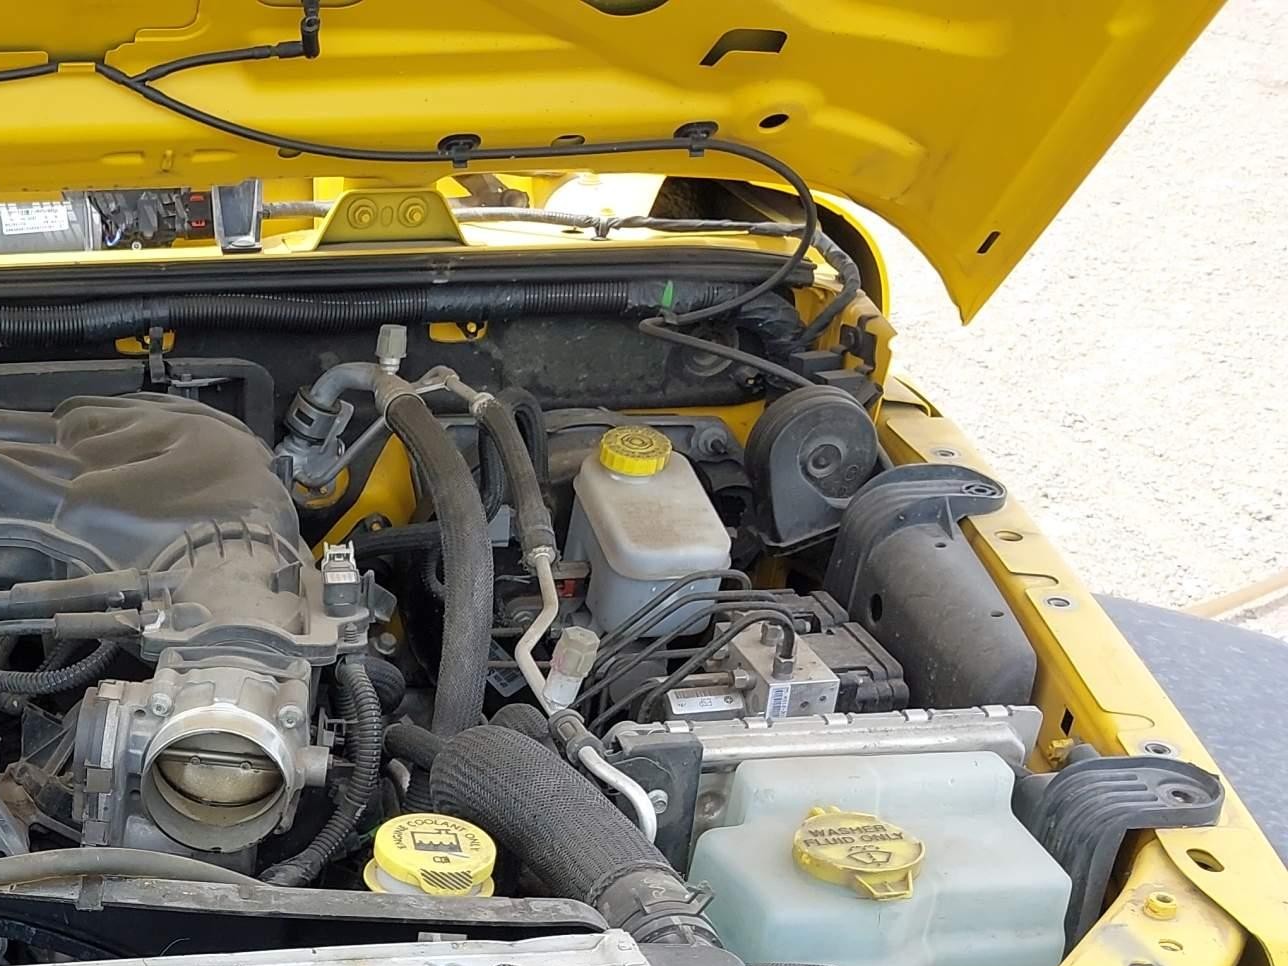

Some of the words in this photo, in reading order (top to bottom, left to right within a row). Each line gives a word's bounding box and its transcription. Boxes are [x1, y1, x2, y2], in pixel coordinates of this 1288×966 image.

[392, 824, 408, 850] ENGINE
[408, 819, 467, 833] COOLANT
[464, 833, 481, 852] ONLY
[808, 824, 887, 838] WASHER
[803, 836, 854, 848] FLUID
[860, 832, 904, 842] ONLY
